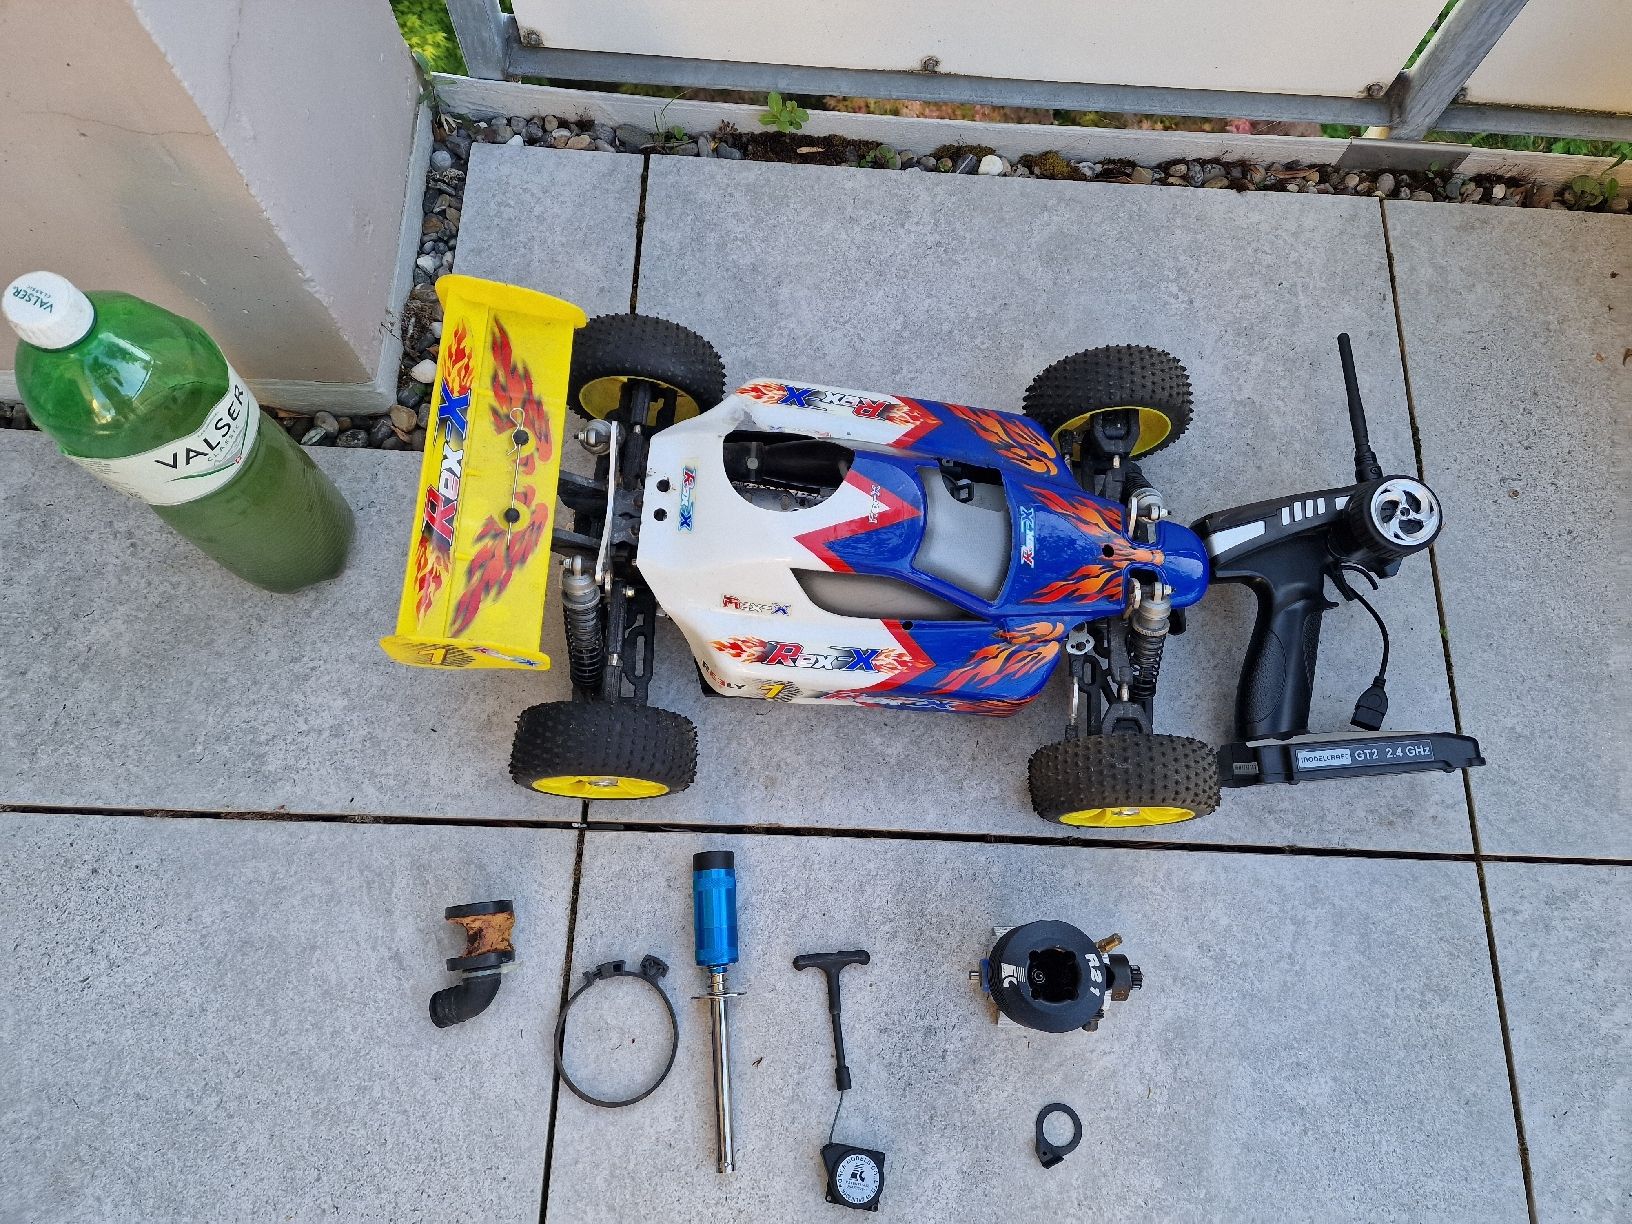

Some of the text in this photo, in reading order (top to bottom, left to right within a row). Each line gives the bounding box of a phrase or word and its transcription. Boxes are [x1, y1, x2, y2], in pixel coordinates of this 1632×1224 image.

[13, 286, 54, 314] VALSER
[154, 384, 244, 470] VALSER
[207, 424, 240, 462] CLASSIC
[1354, 744, 1431, 761] GT2 2.4 GHz
